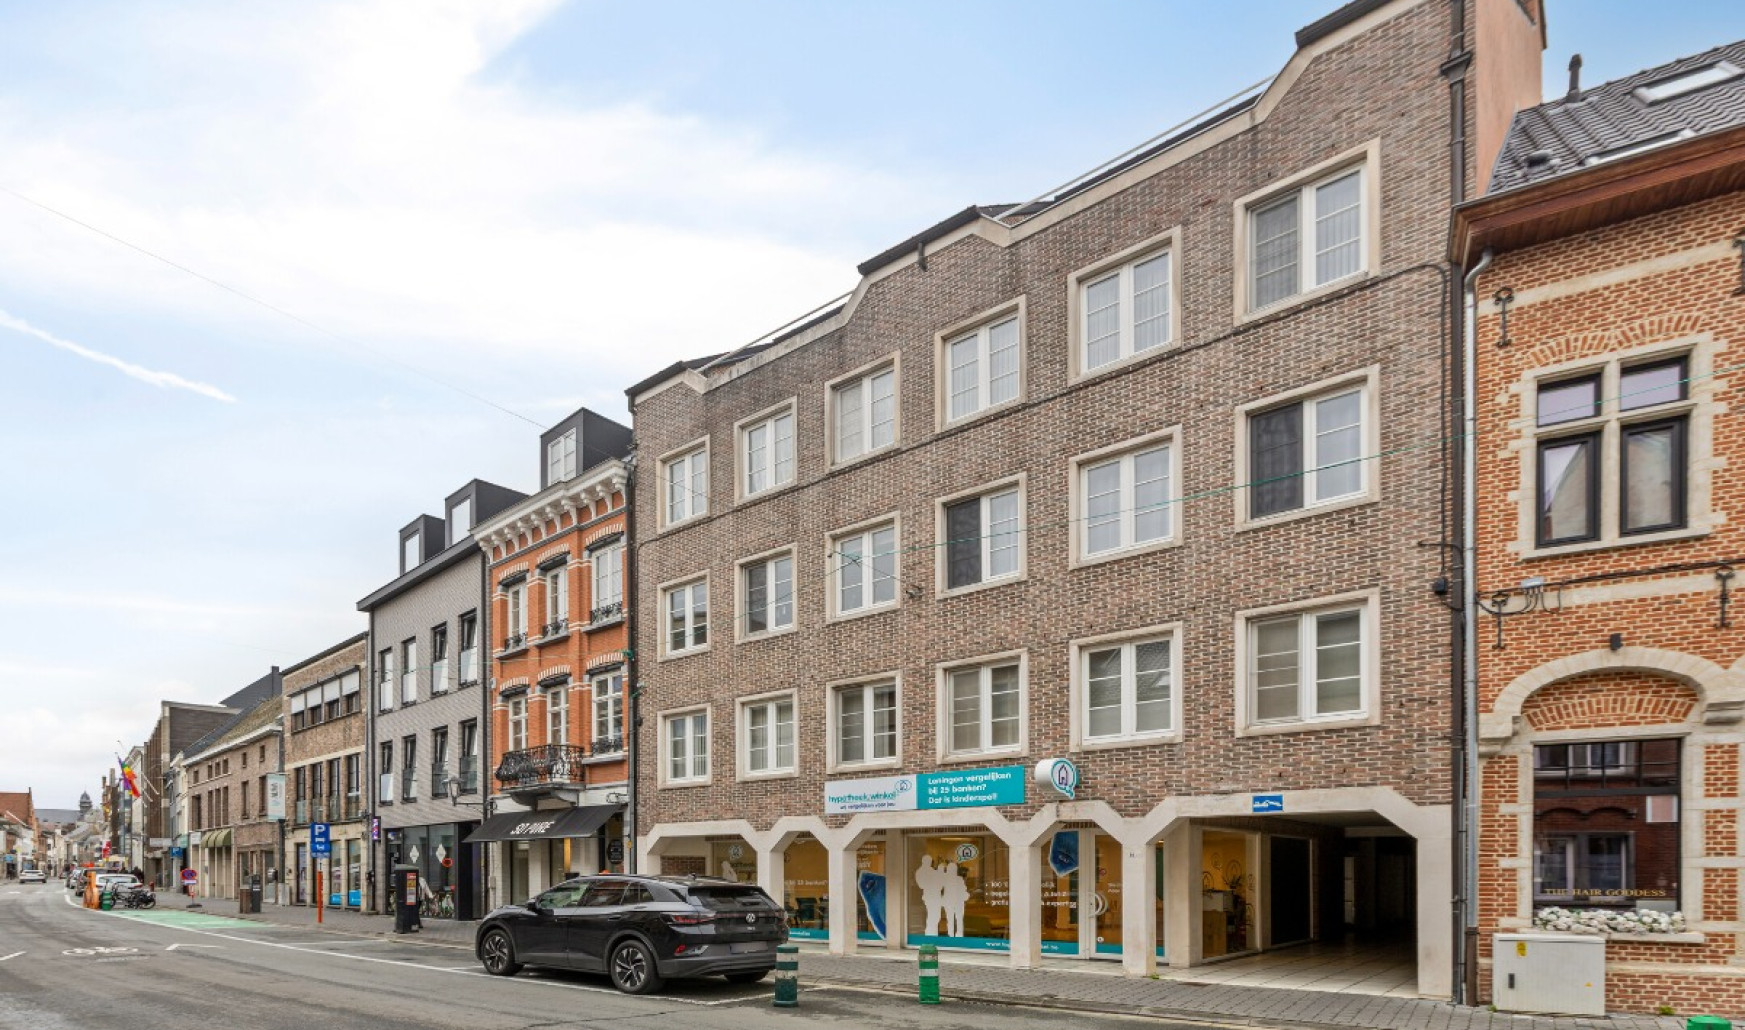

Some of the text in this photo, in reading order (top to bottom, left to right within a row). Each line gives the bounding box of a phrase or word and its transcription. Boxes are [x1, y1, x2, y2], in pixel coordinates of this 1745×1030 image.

[928, 771, 1012, 785] Leningen vergelijken
[952, 783, 987, 794] banken?
[928, 796, 943, 805] Dat
[943, 795, 951, 804] is
[314, 824, 327, 836] P
[1544, 888, 1666, 897] THE HAIR GODDESS
